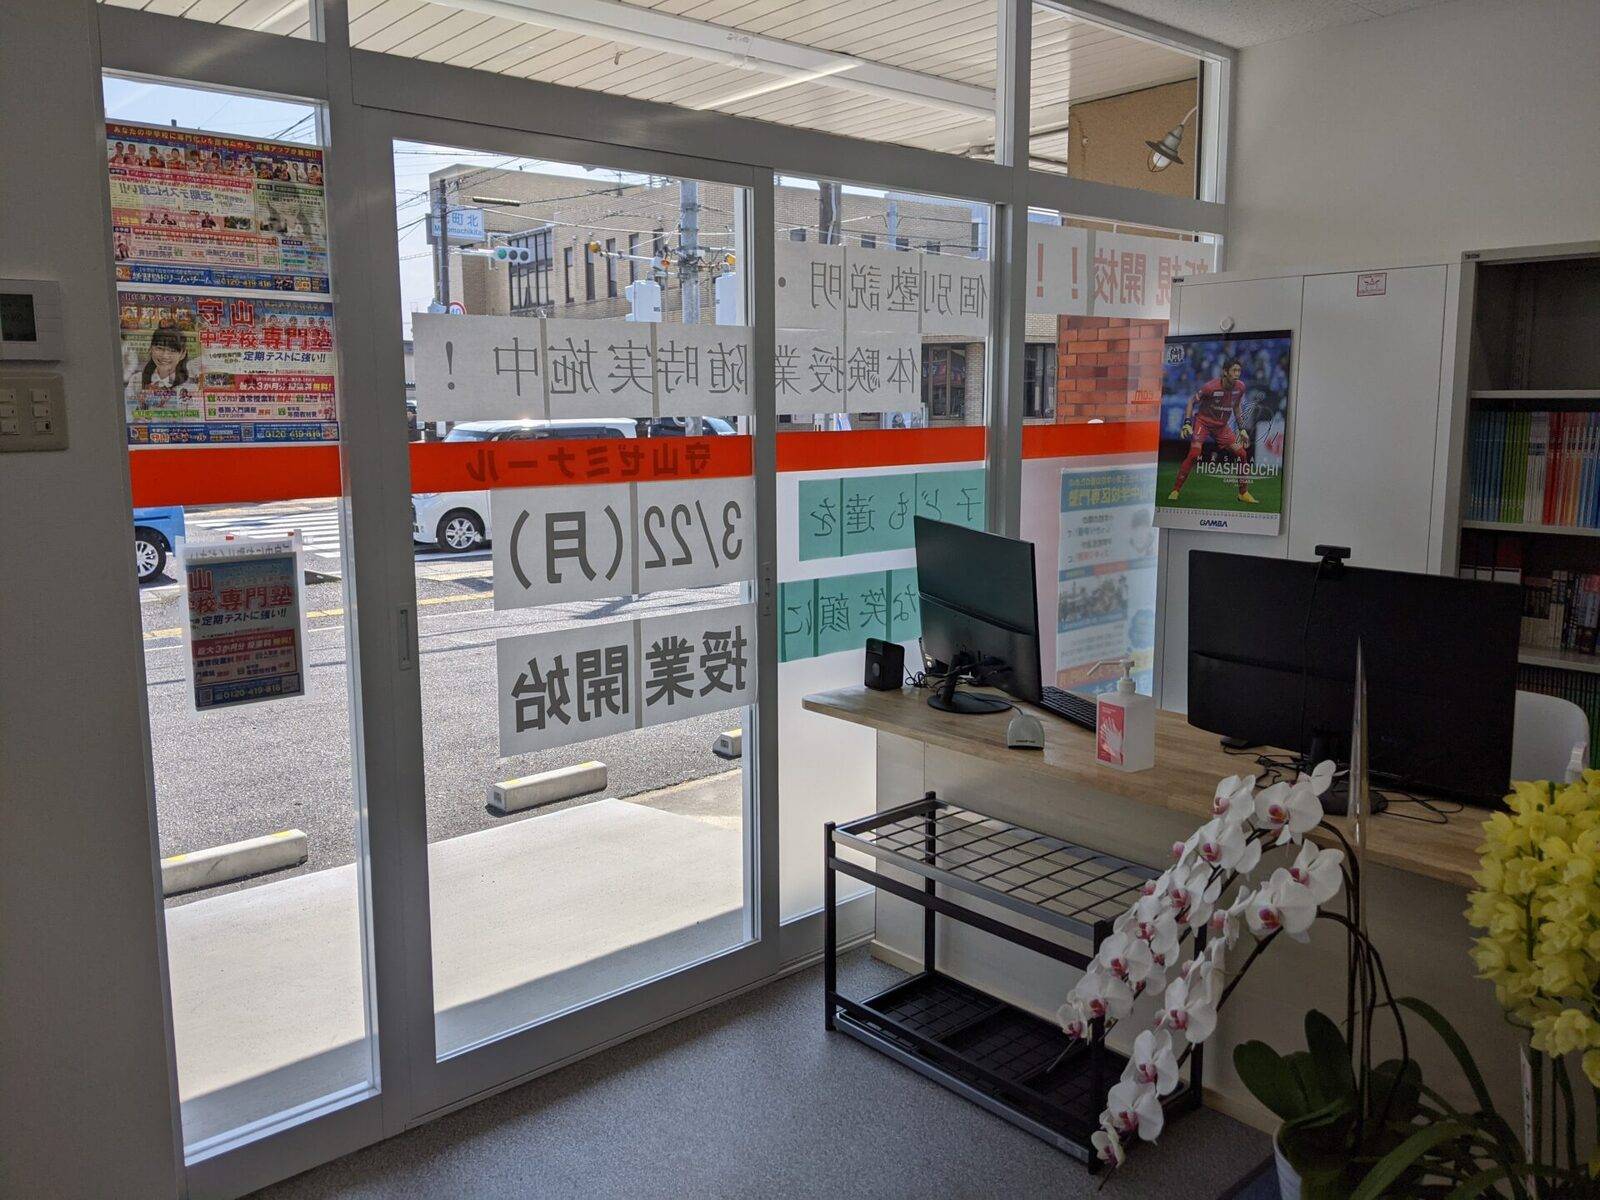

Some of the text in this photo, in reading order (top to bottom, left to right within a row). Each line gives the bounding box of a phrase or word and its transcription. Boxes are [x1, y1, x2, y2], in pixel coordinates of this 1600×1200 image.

[447, 211, 479, 227] 町北
[434, 225, 482, 237] Momachikita
[197, 299, 255, 328] 守山
[199, 328, 258, 350] 中学校
[262, 326, 333, 352] 専門塾
[243, 351, 326, 363] 定期テストに強い!!
[1196, 462, 1278, 476] HIGASHIGUCHI
[1199, 519, 1229, 527] GAMBA
[188, 567, 213, 592] 山
[220, 585, 292, 613] 専門塾
[201, 609, 287, 626] 定期テストに強い!!
